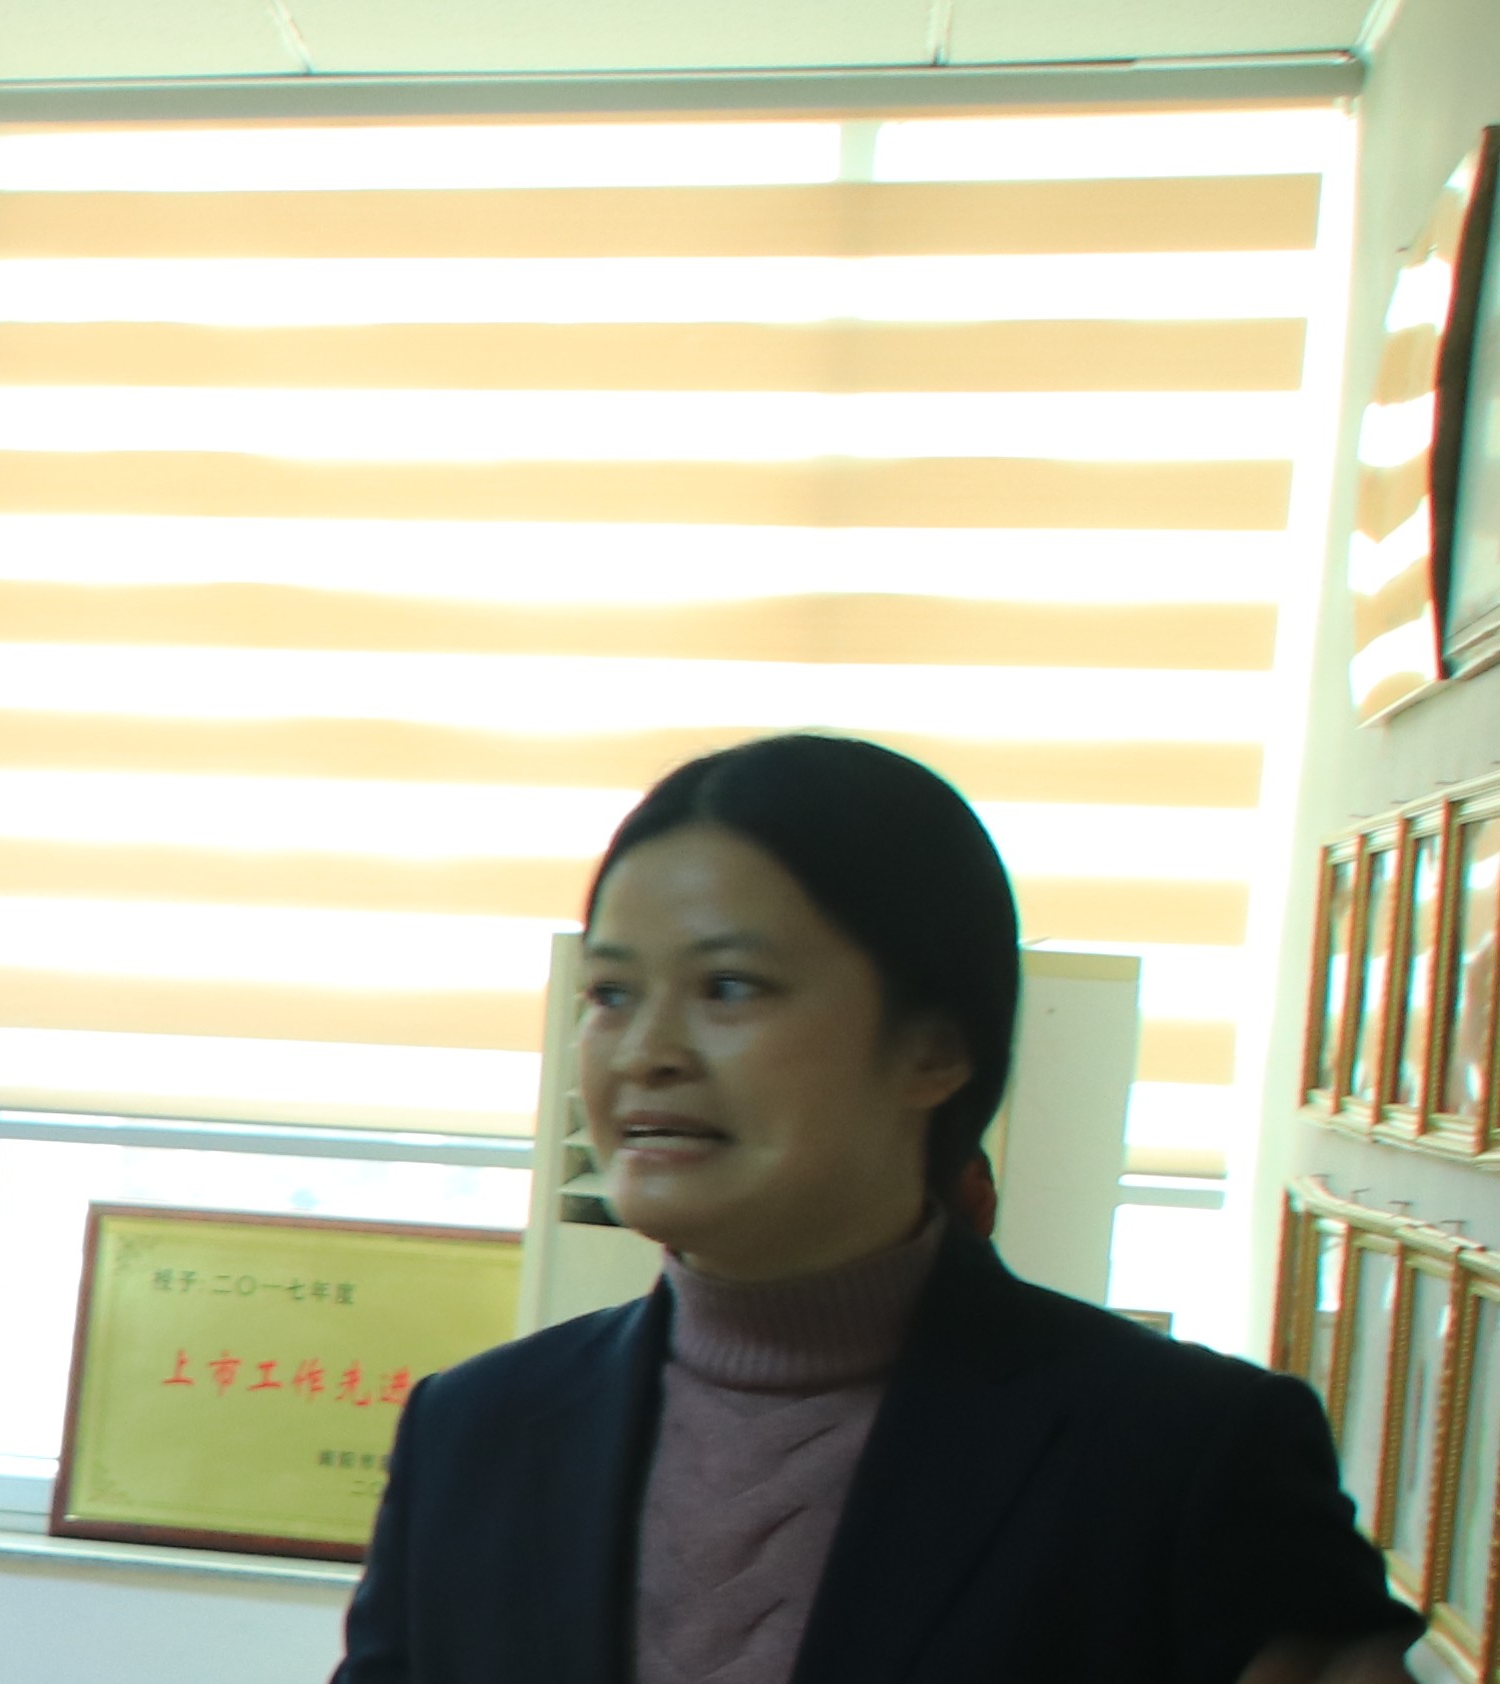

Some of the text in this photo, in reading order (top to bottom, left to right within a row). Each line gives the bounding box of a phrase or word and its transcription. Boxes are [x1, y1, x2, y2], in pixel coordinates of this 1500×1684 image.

[161, 1348, 412, 1408] 上市工作先进
